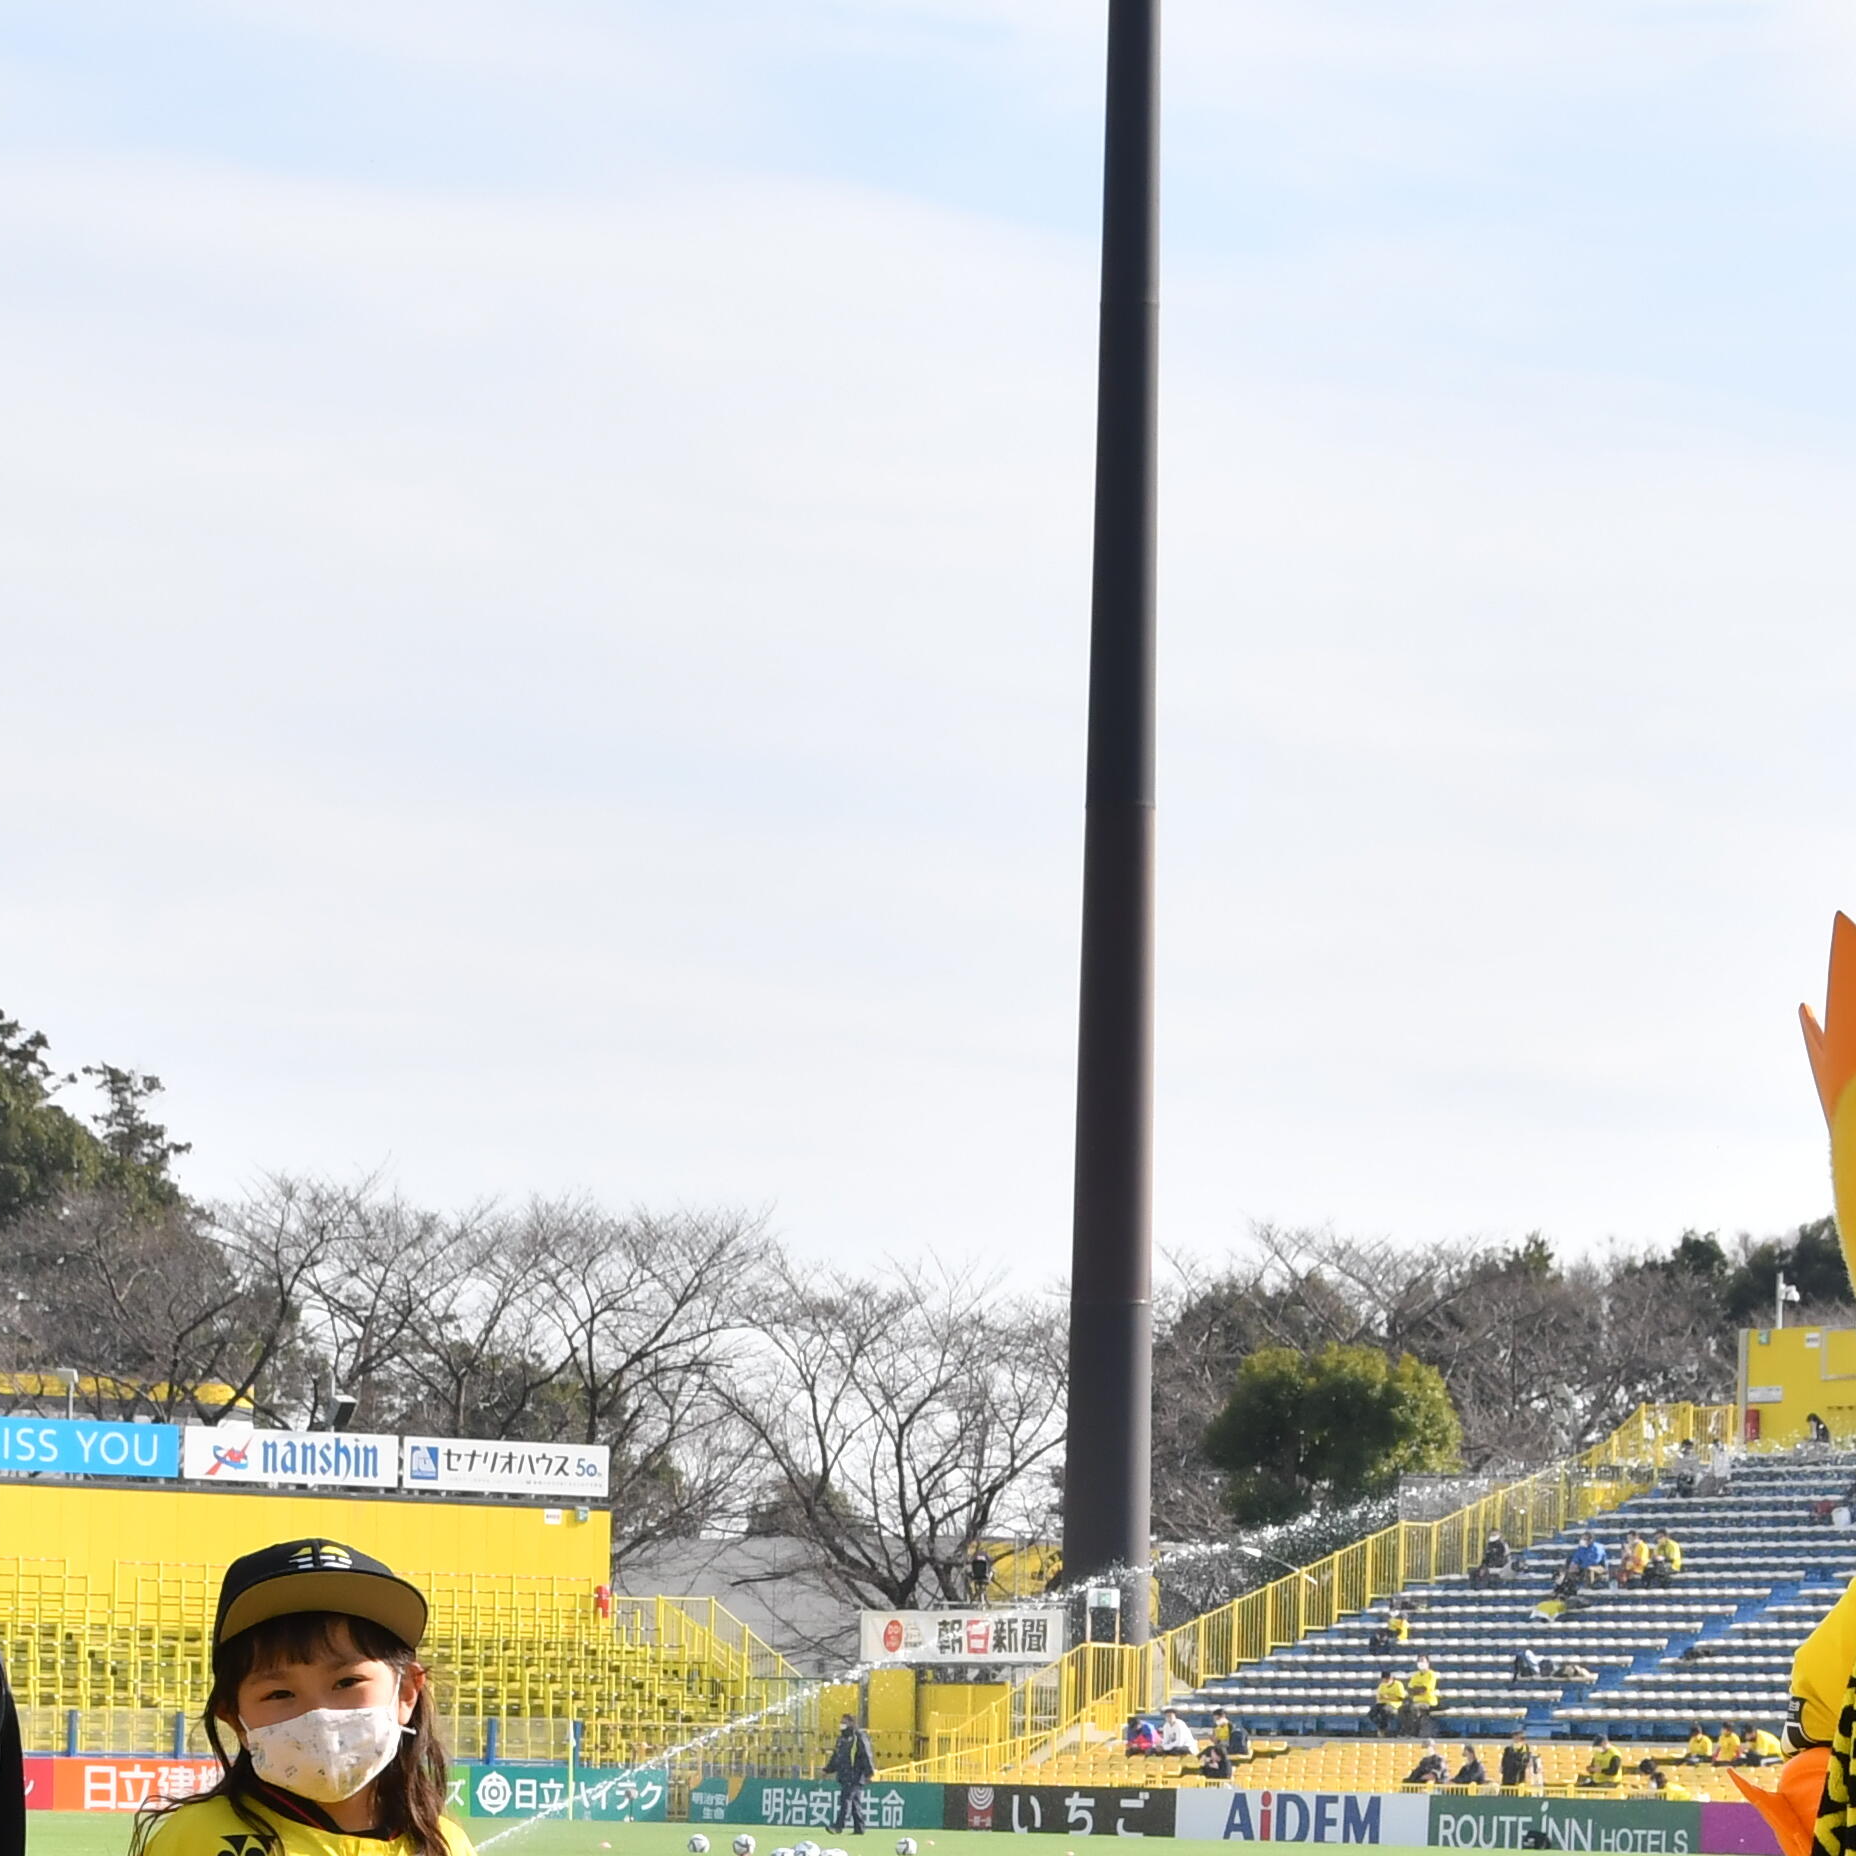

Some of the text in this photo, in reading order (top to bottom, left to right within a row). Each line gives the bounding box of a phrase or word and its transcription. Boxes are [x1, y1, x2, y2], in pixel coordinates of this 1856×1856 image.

[76, 1430, 158, 1466] YOU
[262, 1437, 378, 1481] nanshin
[443, 1448, 570, 1477] セナリオハウス
[937, 1618, 1048, 1655] 朝日新聞
[515, 1778, 663, 1811] 日立ハイテク
[1012, 1791, 1150, 1837] いちご
[1439, 1814, 1533, 1849] ROUTE
[1600, 1827, 1689, 1855] HOTELS
